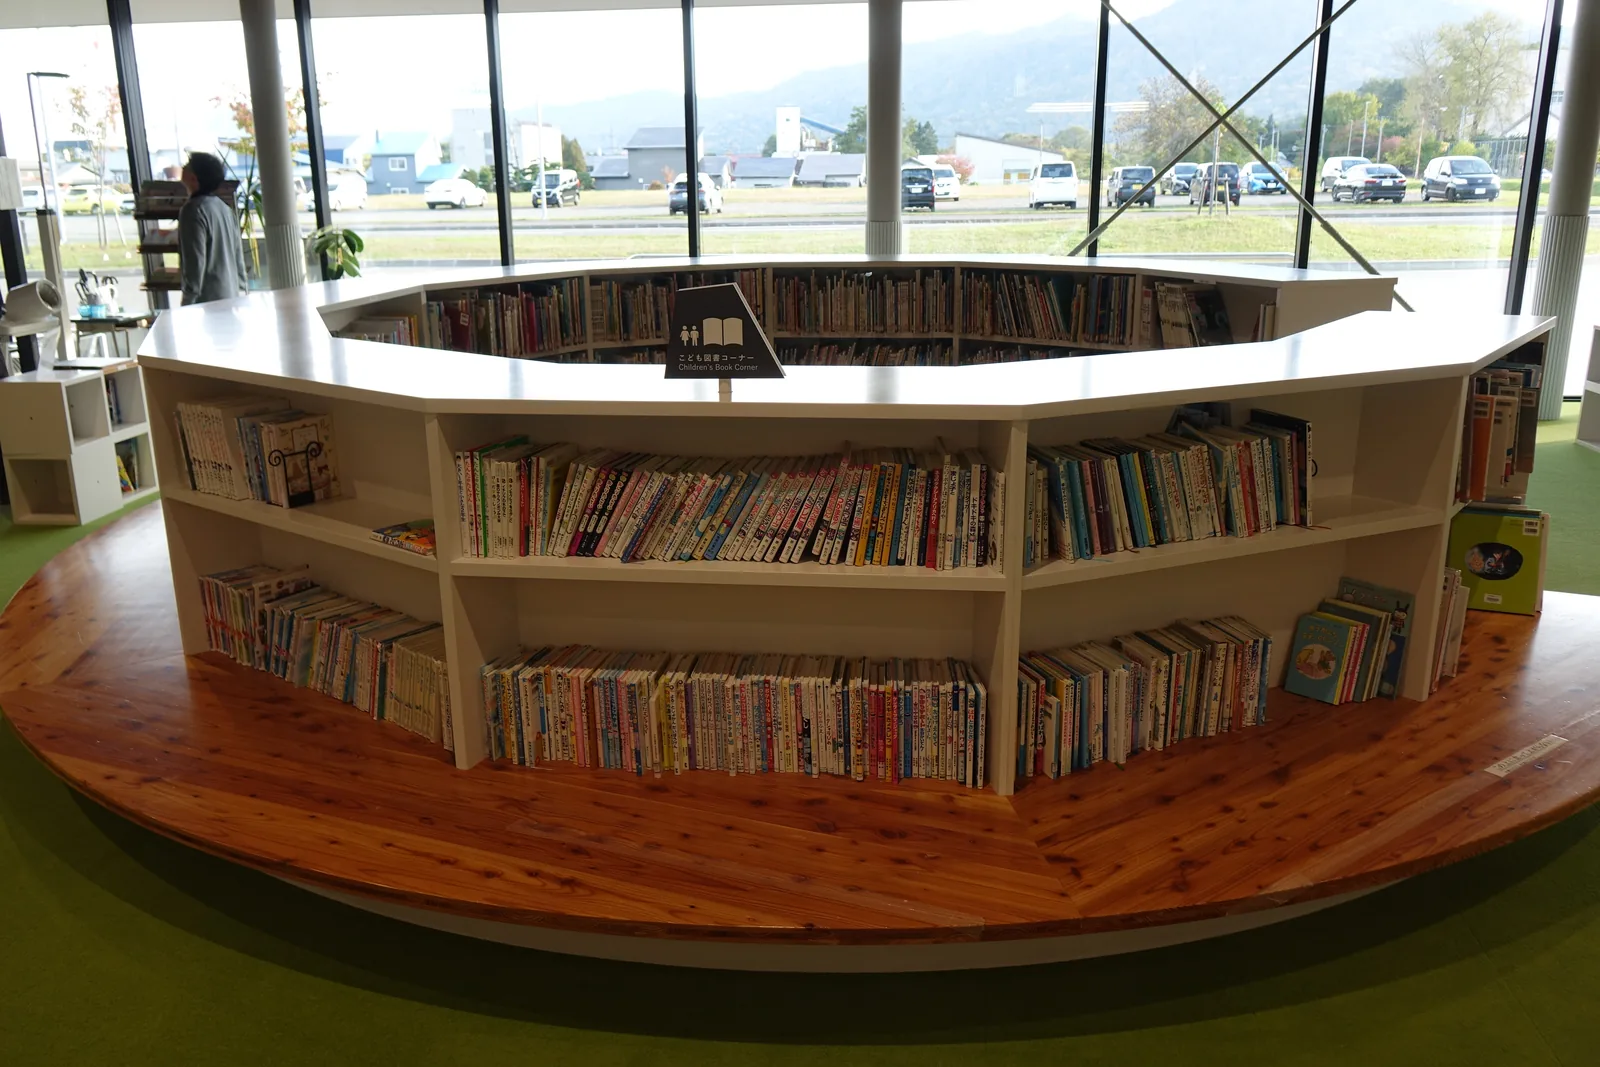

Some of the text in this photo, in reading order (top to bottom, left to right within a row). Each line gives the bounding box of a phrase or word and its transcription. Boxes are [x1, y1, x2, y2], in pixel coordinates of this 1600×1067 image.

[679, 354, 754, 362] こども図書コーナー
